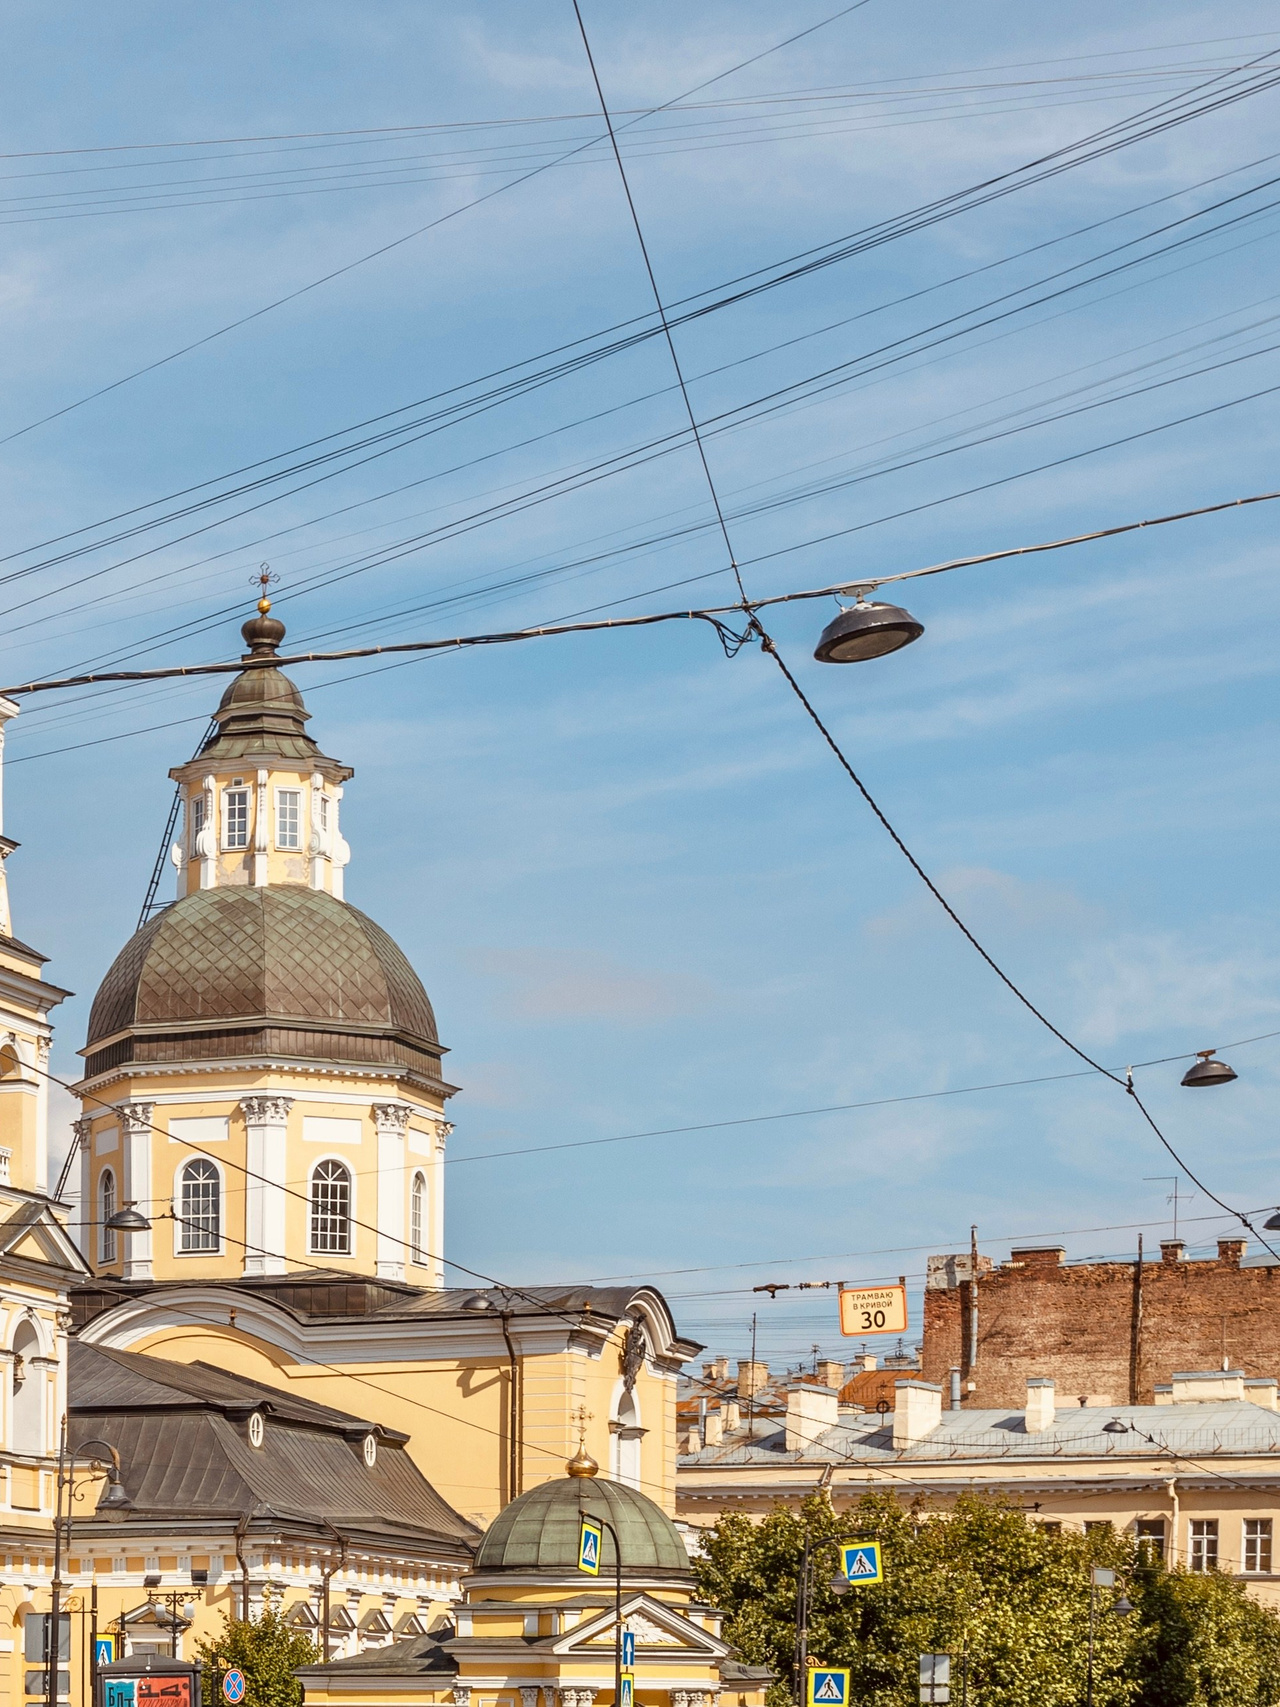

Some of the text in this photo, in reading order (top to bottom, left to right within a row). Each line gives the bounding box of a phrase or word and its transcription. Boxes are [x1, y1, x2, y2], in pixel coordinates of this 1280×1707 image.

[851, 1292, 894, 1301] ТРАМВАЮ
[853, 1299, 893, 1311] В КРИВОЙ
[861, 1310, 886, 1330] 30
